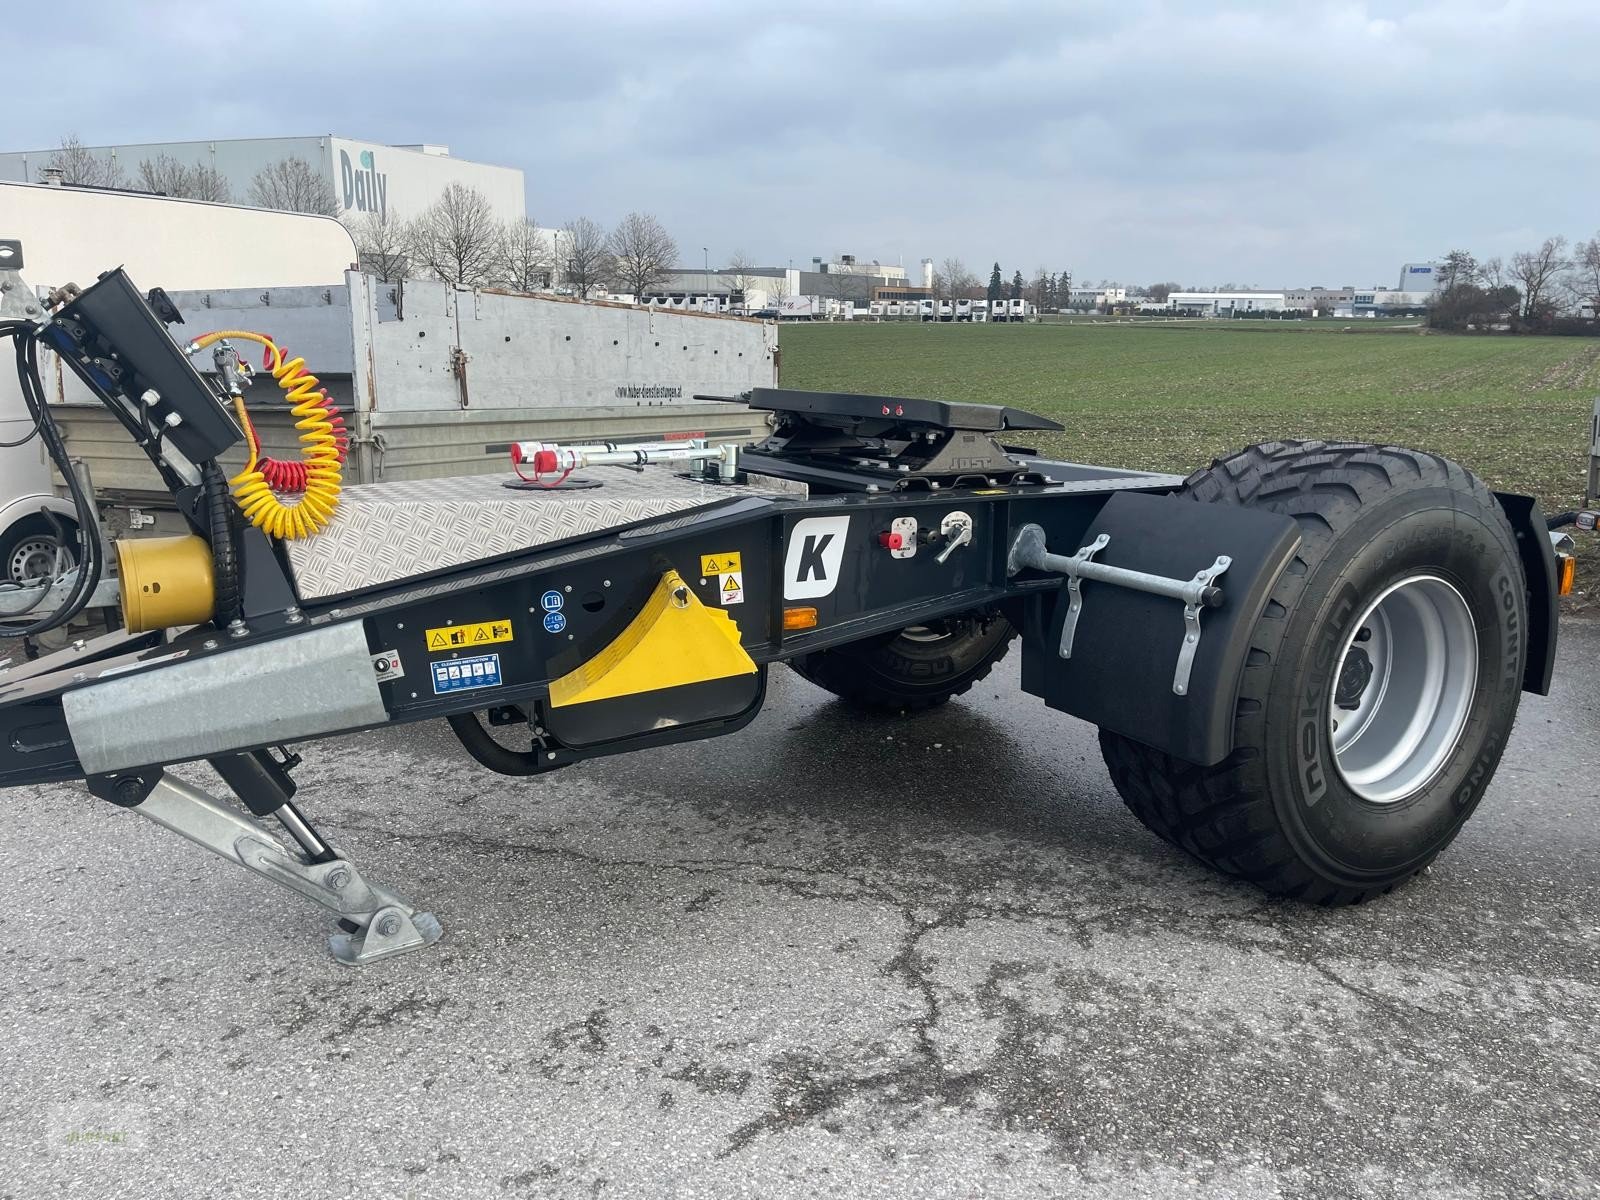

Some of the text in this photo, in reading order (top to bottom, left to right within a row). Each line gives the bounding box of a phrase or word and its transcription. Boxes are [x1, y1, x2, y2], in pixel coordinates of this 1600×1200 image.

[339, 149, 387, 226] Daily
[949, 457, 992, 469] JOST
[796, 534, 835, 582] K
